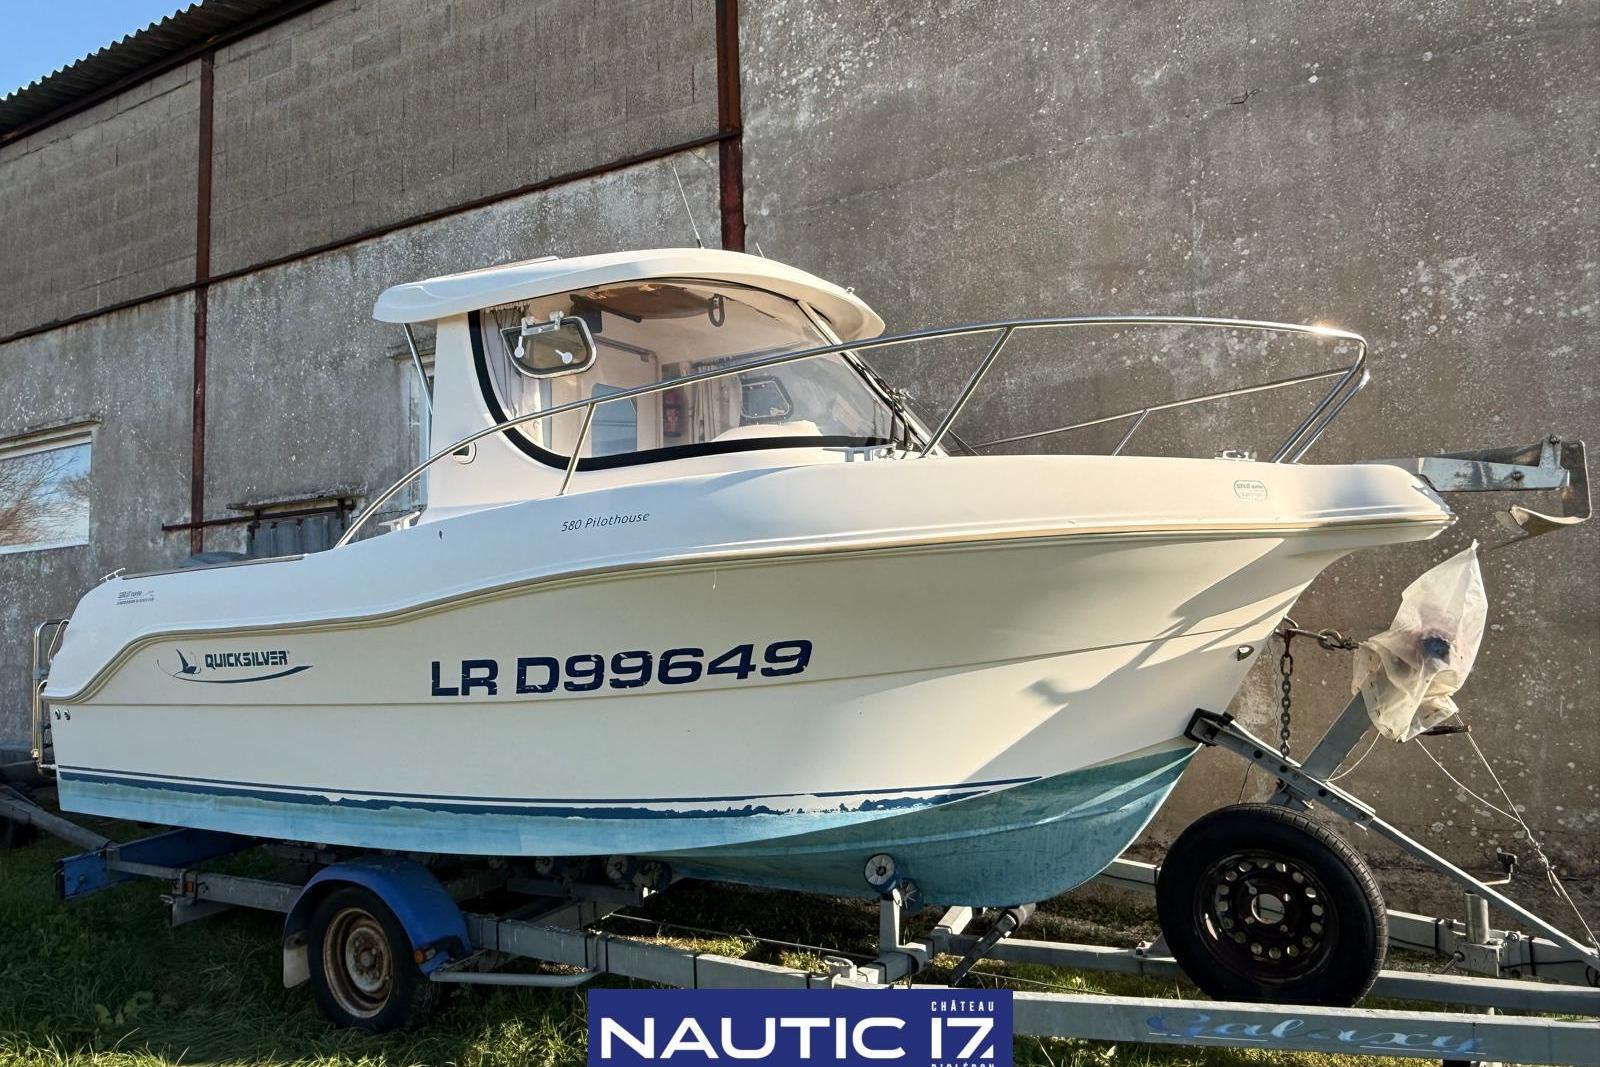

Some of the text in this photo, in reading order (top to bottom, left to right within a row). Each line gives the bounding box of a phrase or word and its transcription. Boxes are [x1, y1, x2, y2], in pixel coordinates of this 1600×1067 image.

[561, 513, 650, 532] 580 Pilothouse
[204, 650, 289, 670] QUICKSILVER
[431, 639, 813, 697] LR D99649
